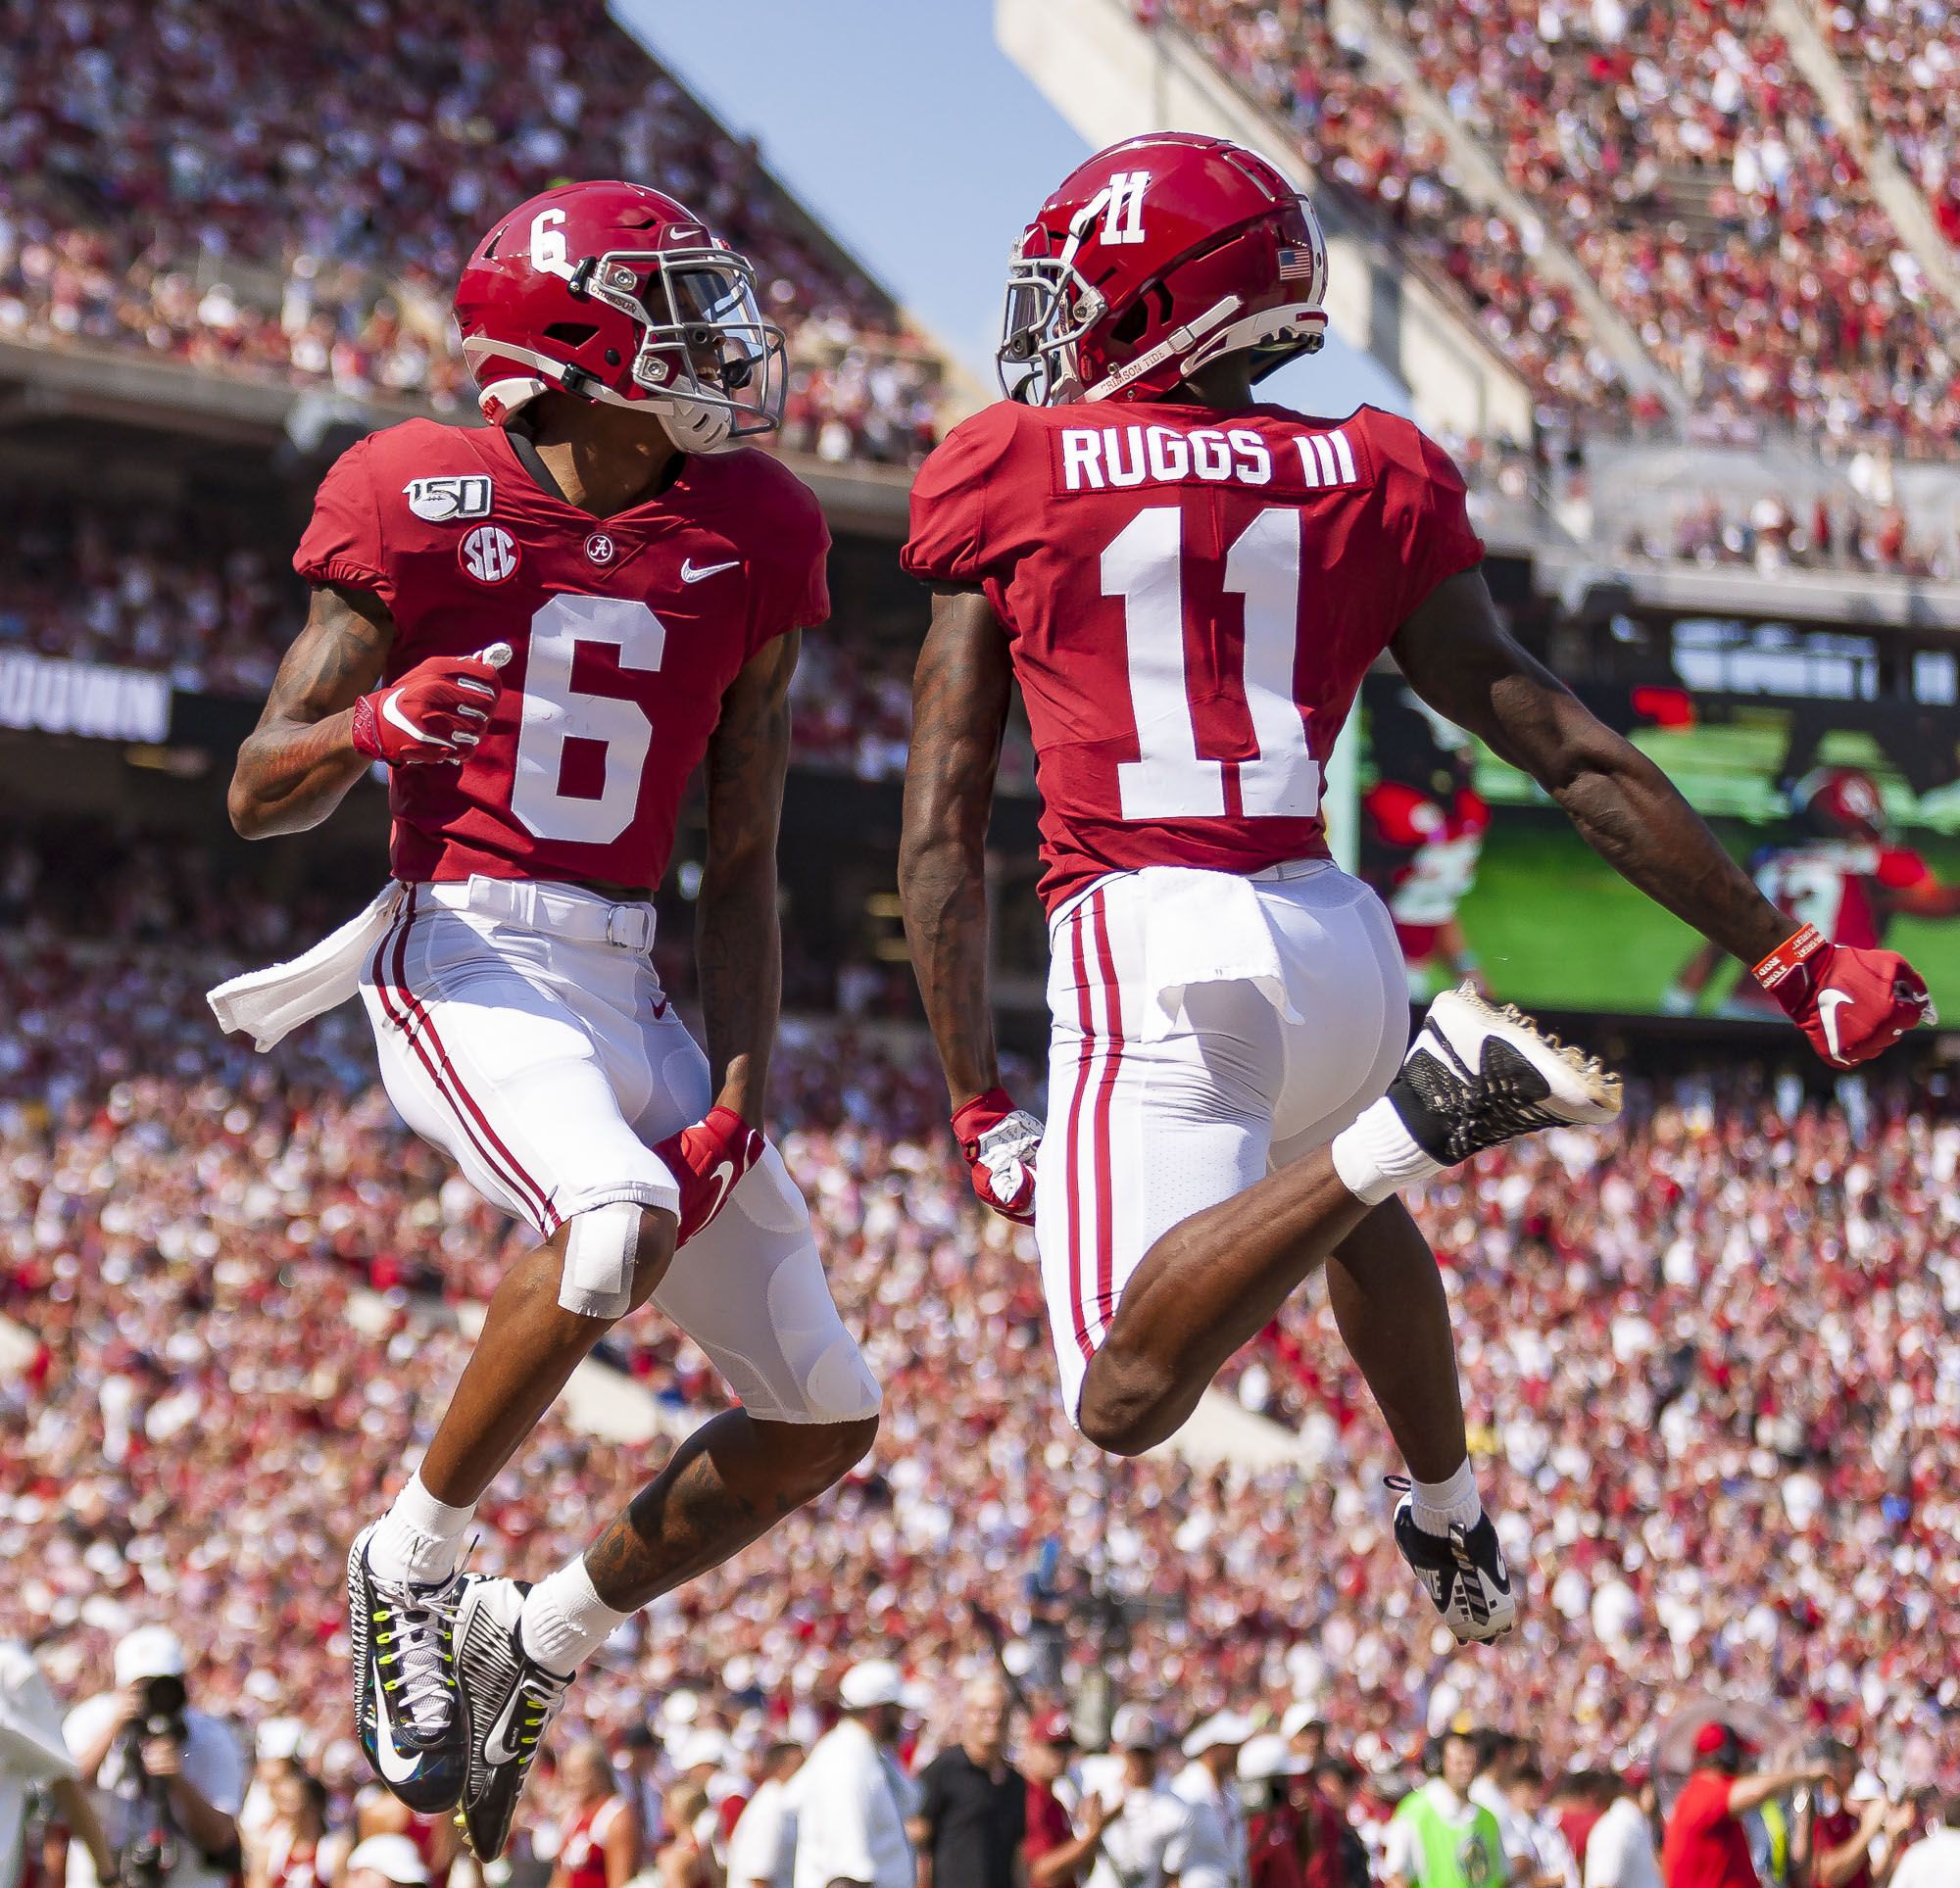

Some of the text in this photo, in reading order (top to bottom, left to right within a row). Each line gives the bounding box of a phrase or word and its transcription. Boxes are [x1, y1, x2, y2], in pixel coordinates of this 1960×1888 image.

[529, 208, 567, 273] 6
[1100, 171, 1151, 246] 11
[1144, 349, 1166, 369] TIDE
[1061, 424, 1357, 490] RUGGS III
[403, 476, 490, 521] 150
[464, 526, 516, 582] SEC
[1100, 506, 1320, 821] 11
[512, 594, 666, 844] 6
